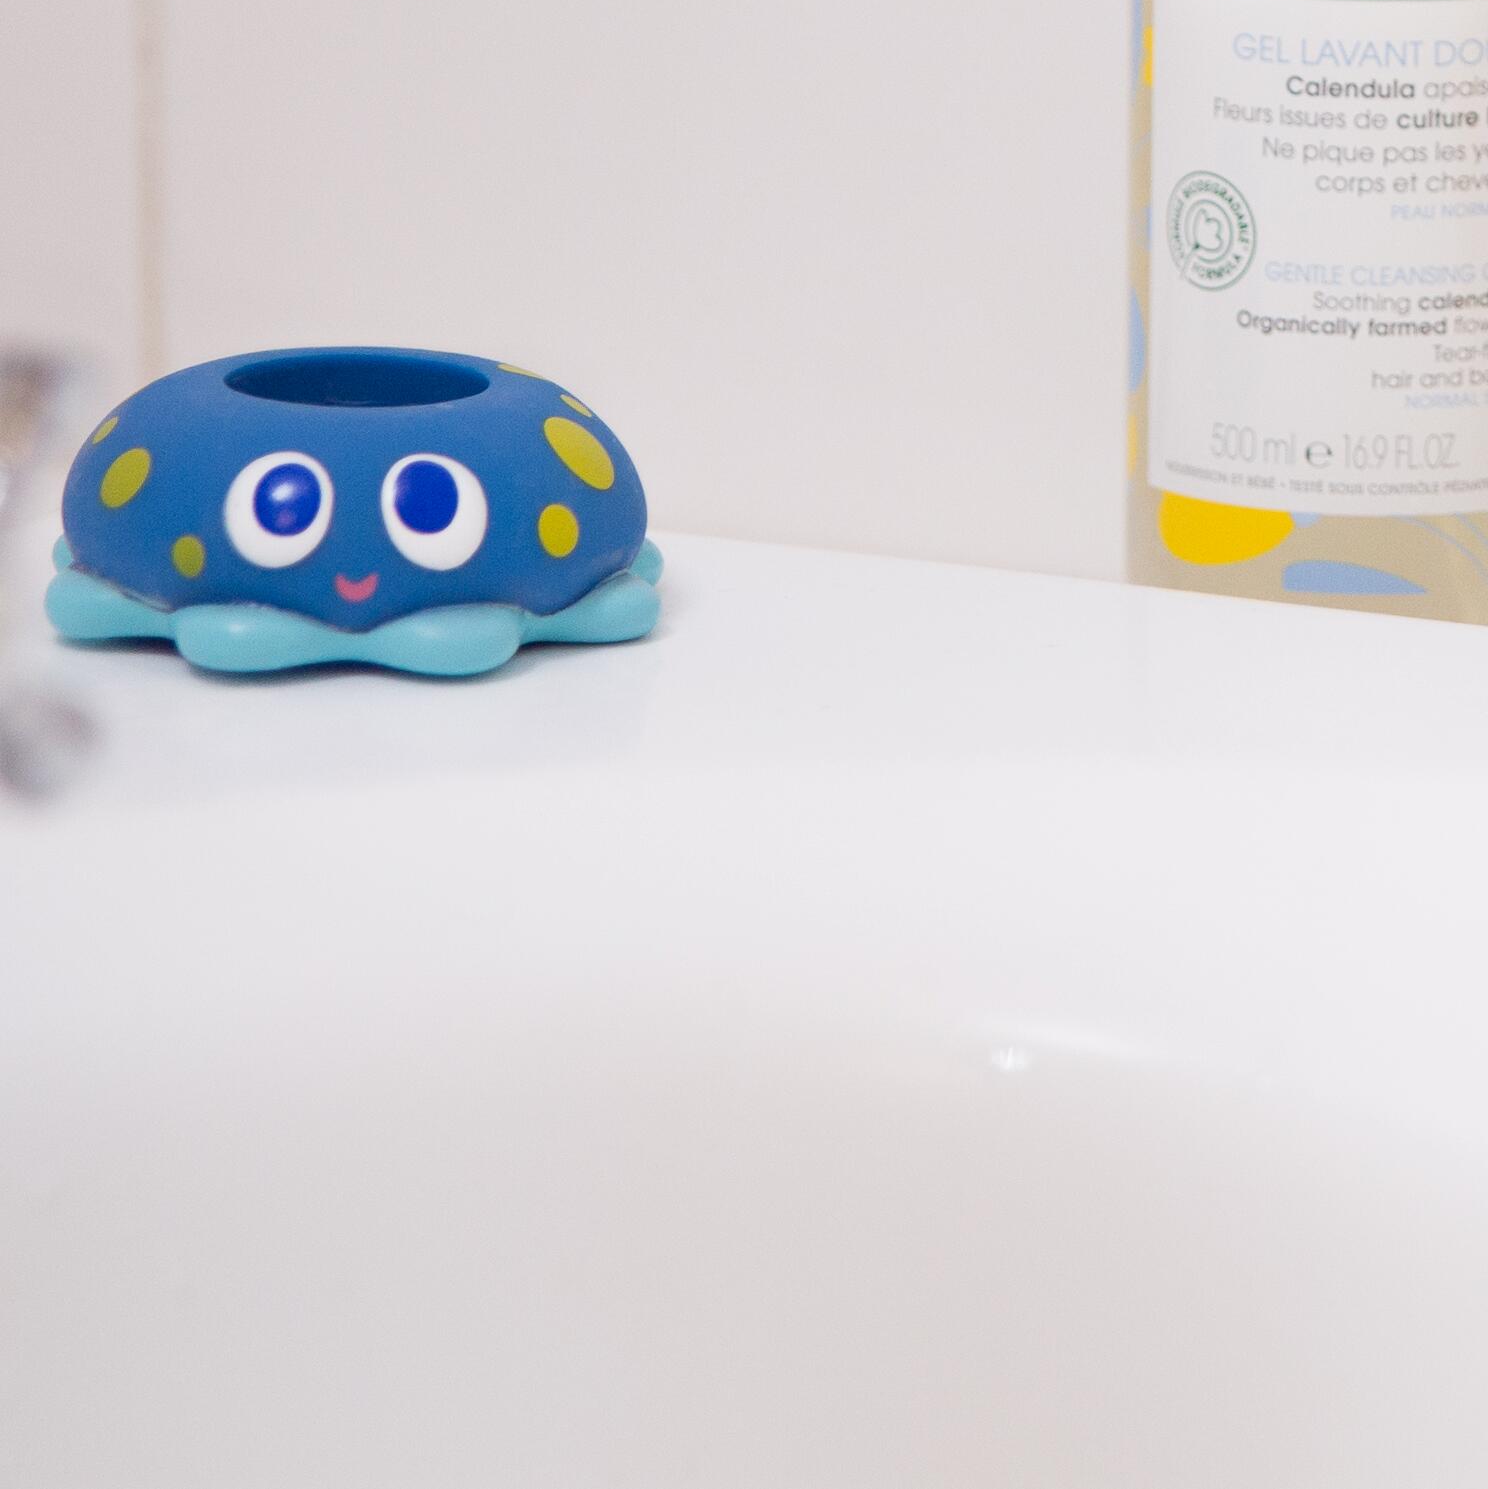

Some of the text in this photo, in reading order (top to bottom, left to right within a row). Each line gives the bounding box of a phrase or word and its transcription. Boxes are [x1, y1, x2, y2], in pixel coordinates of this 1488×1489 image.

[1233, 32, 1291, 64] GEL
[1301, 37, 1424, 67] LAVANT
[1286, 75, 1415, 99] Calendula
[1213, 96, 1272, 124] Fleurs
[1279, 100, 1346, 129] issues
[1354, 105, 1387, 129] de
[1396, 105, 1478, 129] culture
[1262, 136, 1294, 159] Ne
[1303, 141, 1374, 166] pique
[1383, 142, 1427, 166] pas
[1435, 139, 1465, 160] les
[1315, 174, 1386, 196] corps
[1392, 173, 1417, 193] et
[1391, 204, 1433, 220] PEAU
[1264, 260, 1341, 285] GENTLE
[1350, 263, 1475, 287] CLEANSING
[1313, 291, 1411, 315] Soothing
[1237, 309, 1360, 339] Organically
[1368, 312, 1447, 336] farmed
[1371, 370, 1412, 389] hair
[1419, 368, 1463, 387] and
[1211, 422, 1257, 462] 500
[1264, 432, 1296, 465] ml
